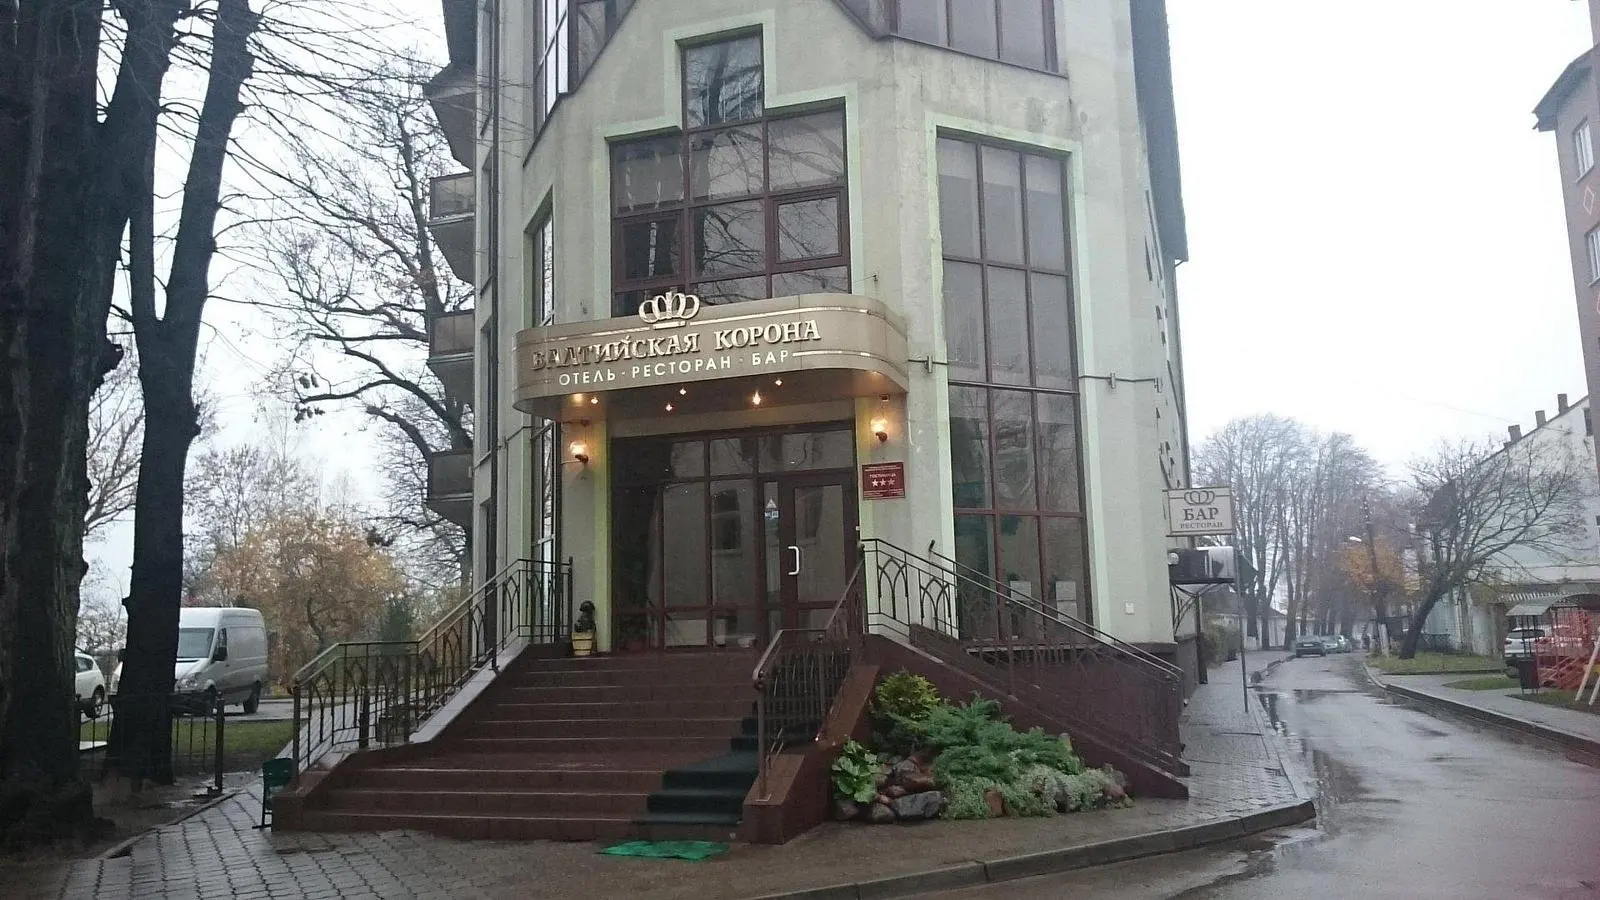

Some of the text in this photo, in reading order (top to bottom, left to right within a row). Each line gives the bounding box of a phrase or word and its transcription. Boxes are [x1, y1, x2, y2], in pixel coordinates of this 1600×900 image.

[530, 320, 821, 370] БАЛТИЙСКАЯ КОРОНА
[559, 350, 789, 386] ОТЕЛЬ РЕСТОРАН БАР
[1180, 521, 1223, 529] РЕСТОРАН
[1183, 507, 1219, 521] БАР
